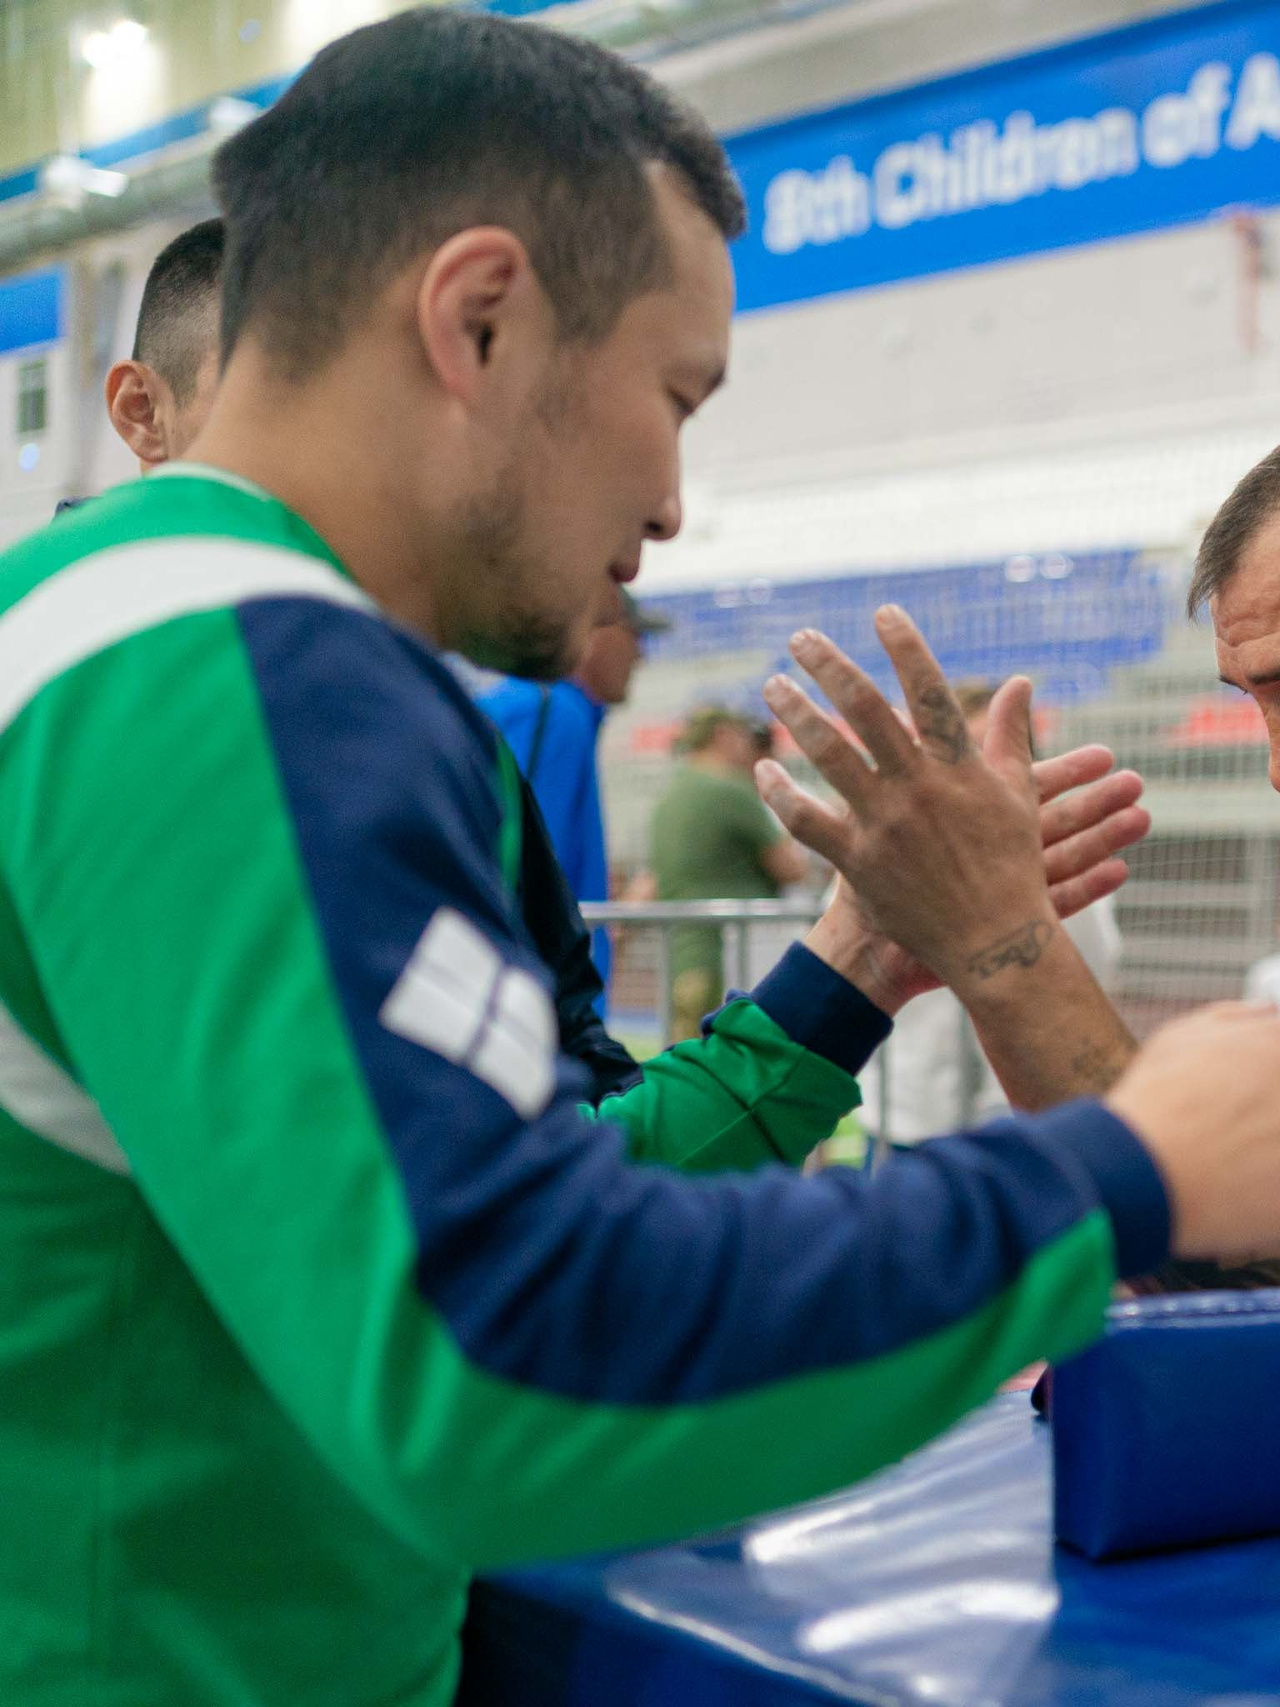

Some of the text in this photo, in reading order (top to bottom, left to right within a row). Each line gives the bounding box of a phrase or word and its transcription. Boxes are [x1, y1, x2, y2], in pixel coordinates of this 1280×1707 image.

[764, 155, 872, 254] 8th
[873, 109, 1140, 230] Children
[1142, 62, 1230, 168] of
